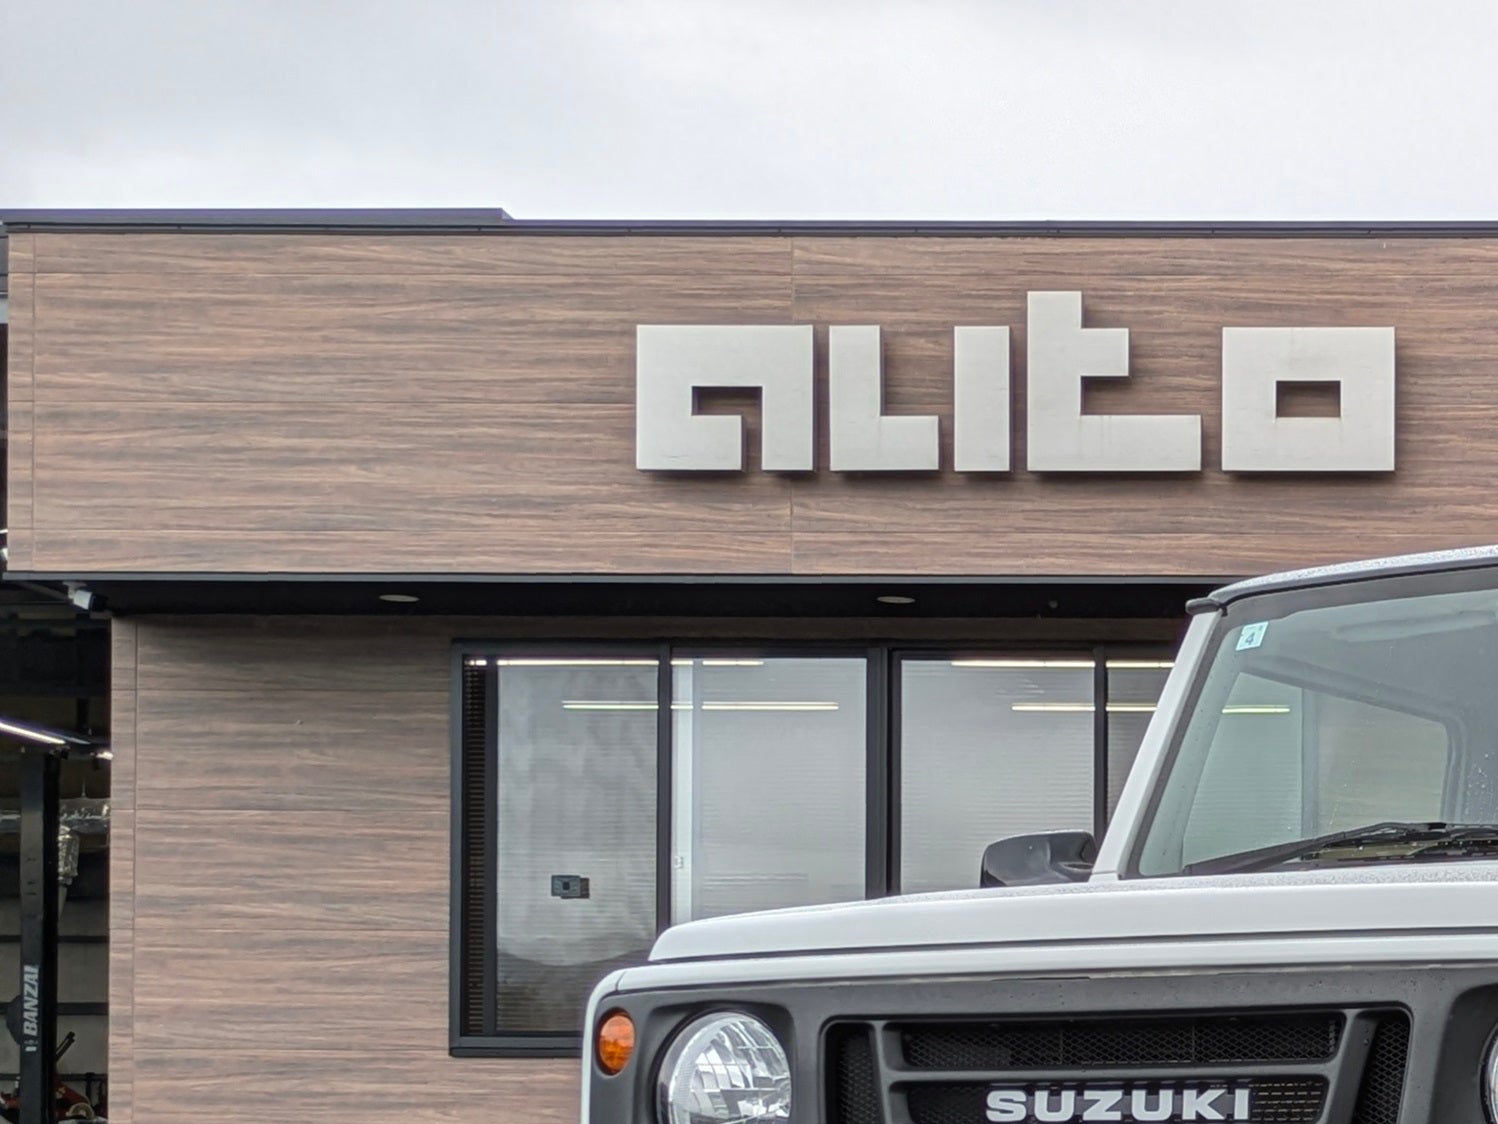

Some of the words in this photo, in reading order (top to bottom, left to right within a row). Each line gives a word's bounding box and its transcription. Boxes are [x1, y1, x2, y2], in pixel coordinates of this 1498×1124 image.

[636, 291, 1396, 471] auto
[23, 965, 40, 1036] BANZAI
[986, 1088, 1250, 1123] SUZUKI
